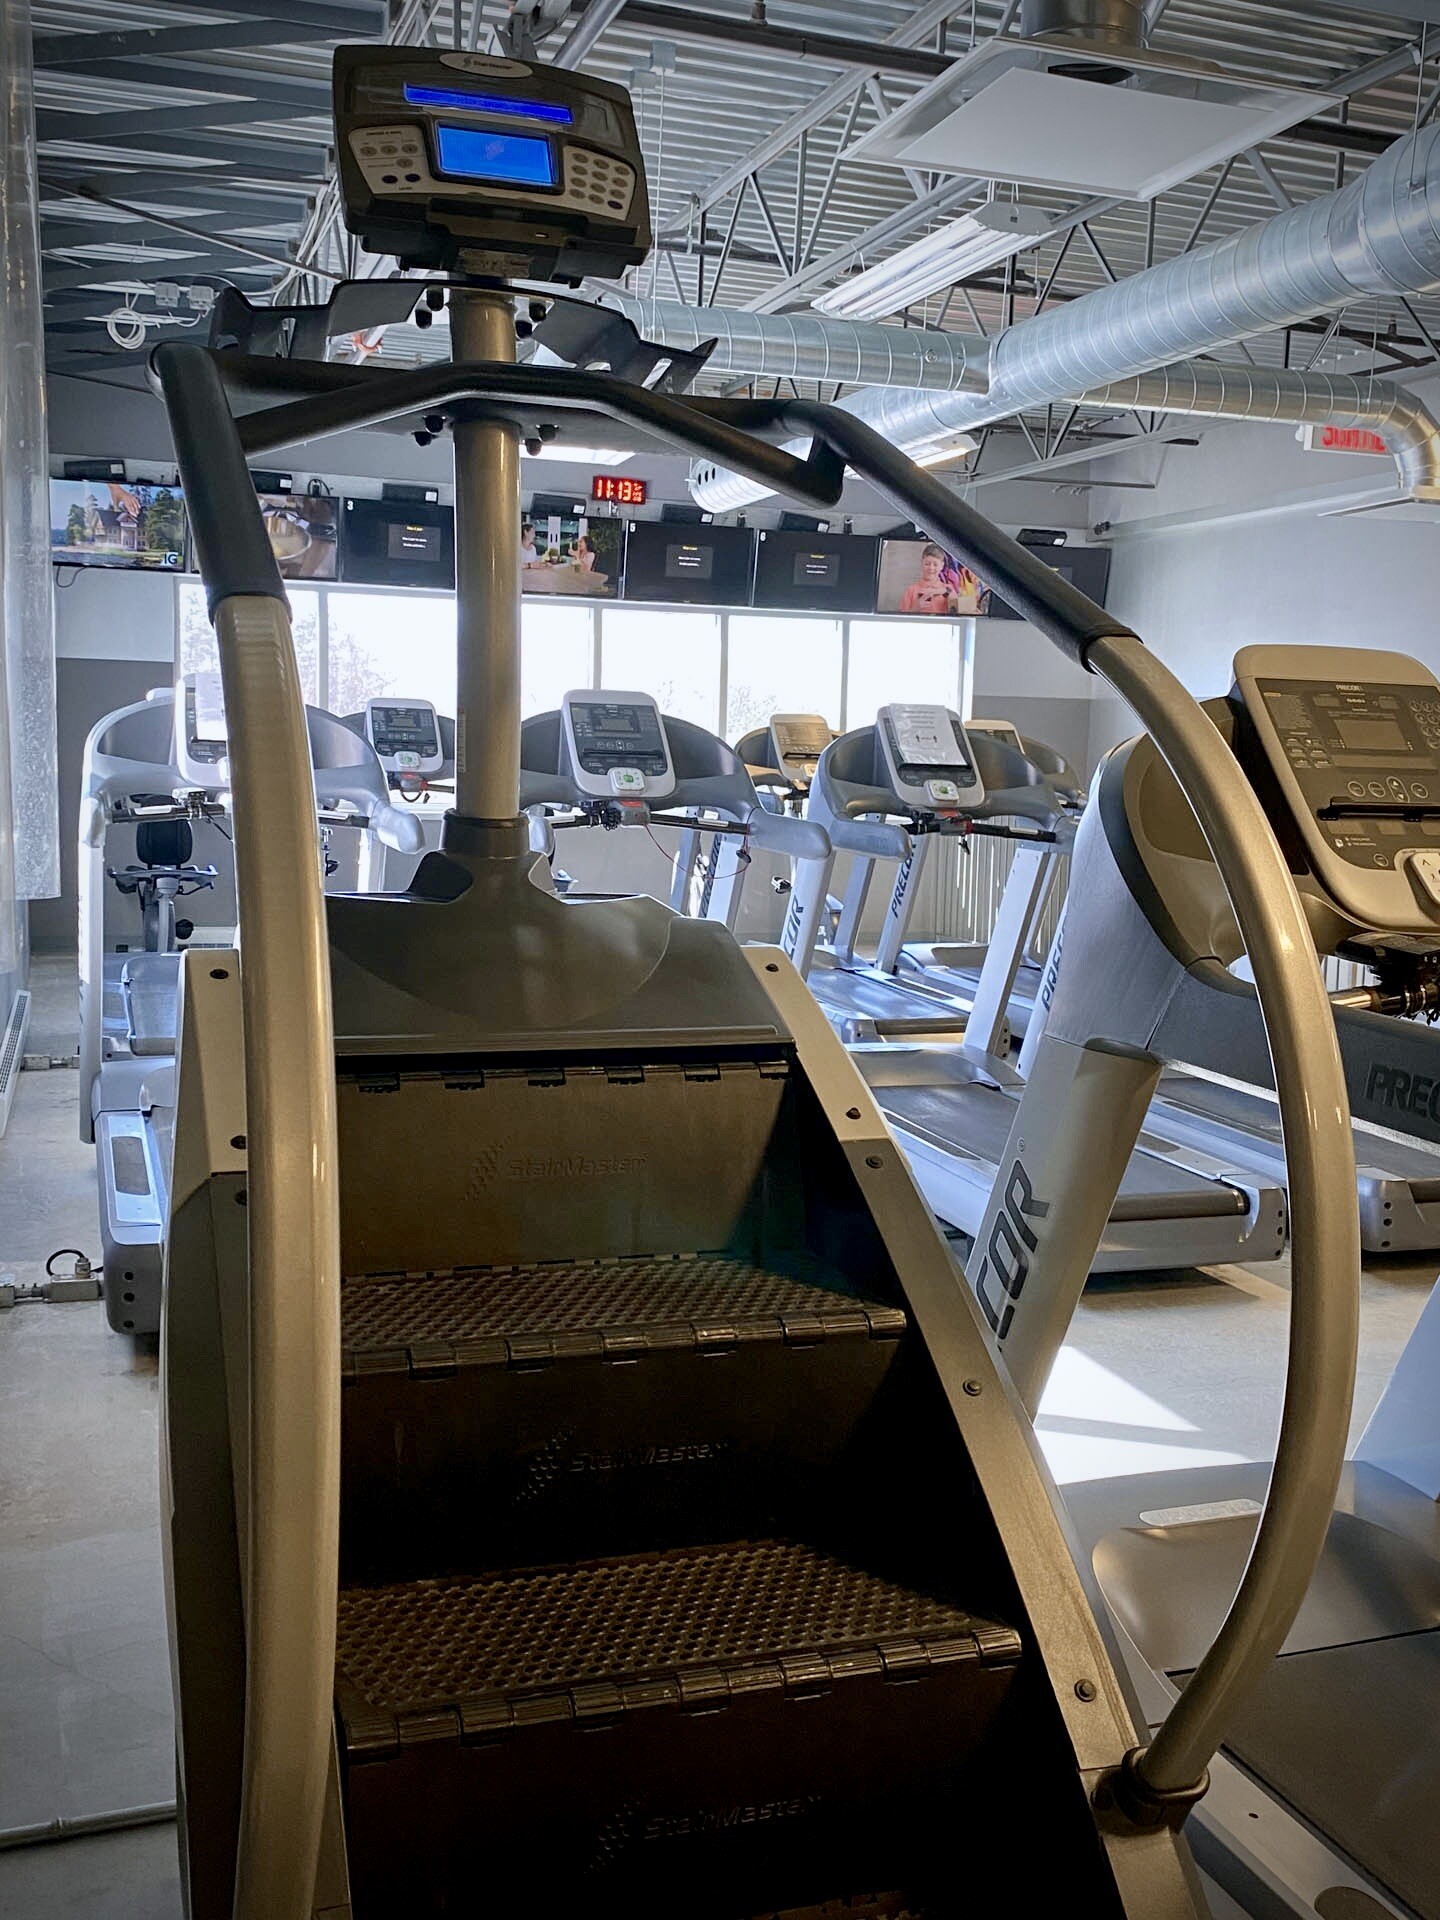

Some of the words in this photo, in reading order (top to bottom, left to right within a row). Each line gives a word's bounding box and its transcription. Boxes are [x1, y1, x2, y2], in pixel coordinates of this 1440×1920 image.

[347, 500, 354, 511] 3
[629, 523, 636, 533] 5
[783, 894, 804, 961] COR
[975, 1158, 1050, 1352] COR
